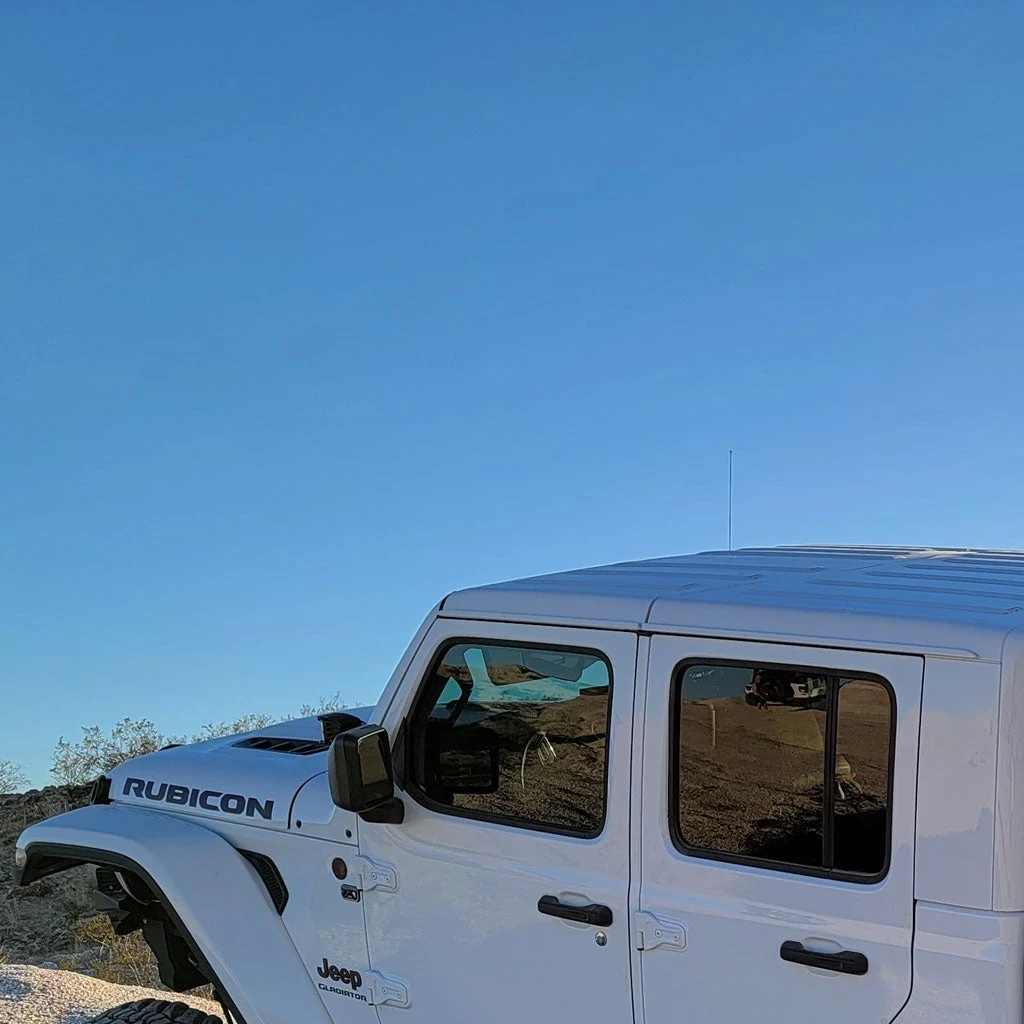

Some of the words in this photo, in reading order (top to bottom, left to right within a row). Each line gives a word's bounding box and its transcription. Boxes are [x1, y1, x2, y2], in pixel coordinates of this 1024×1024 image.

[122, 777, 275, 820] RUBICON
[316, 957, 363, 991] Jeep
[318, 983, 368, 1003] GLADIATOR
